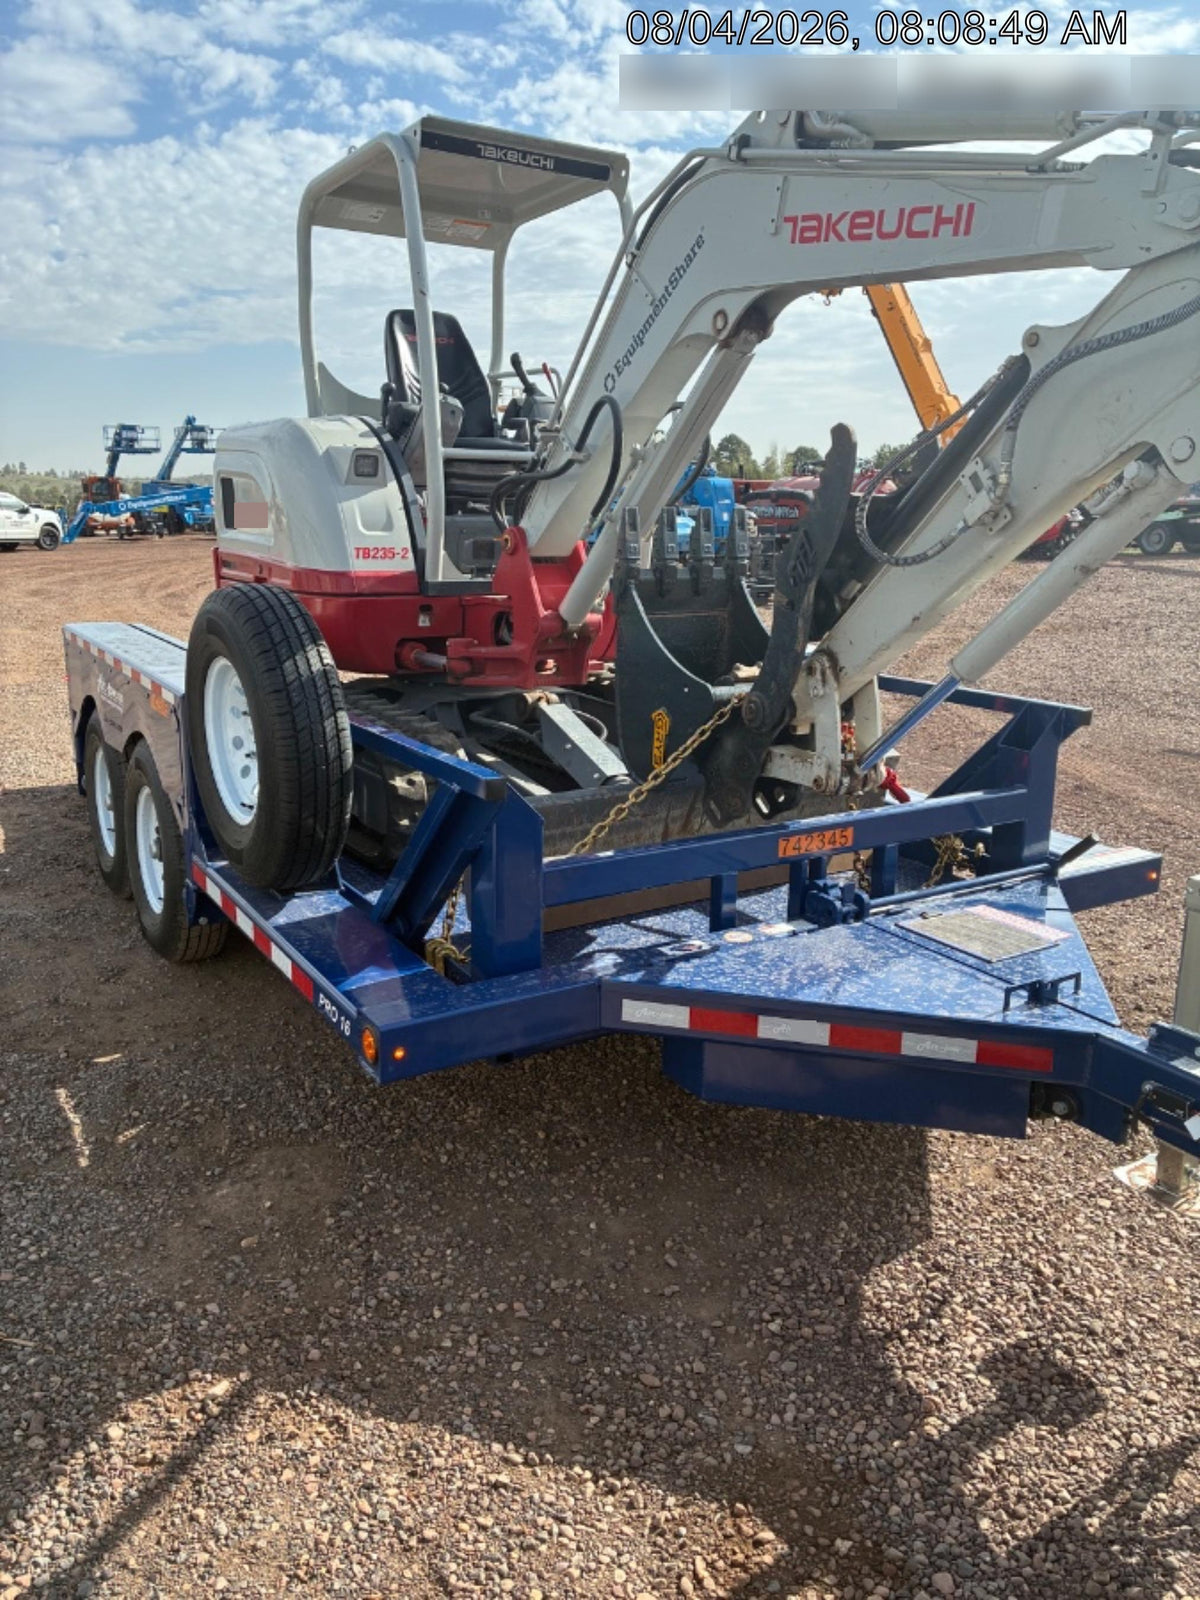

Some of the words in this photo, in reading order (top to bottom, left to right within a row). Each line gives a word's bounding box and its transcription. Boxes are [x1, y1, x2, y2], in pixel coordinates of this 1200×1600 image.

[613, 232, 706, 379] EquipmentShare
[354, 546, 409, 559] TB235-2
[781, 828, 849, 856] 742345
[318, 993, 338, 1023] PRO
[340, 1016, 351, 1036] 16
